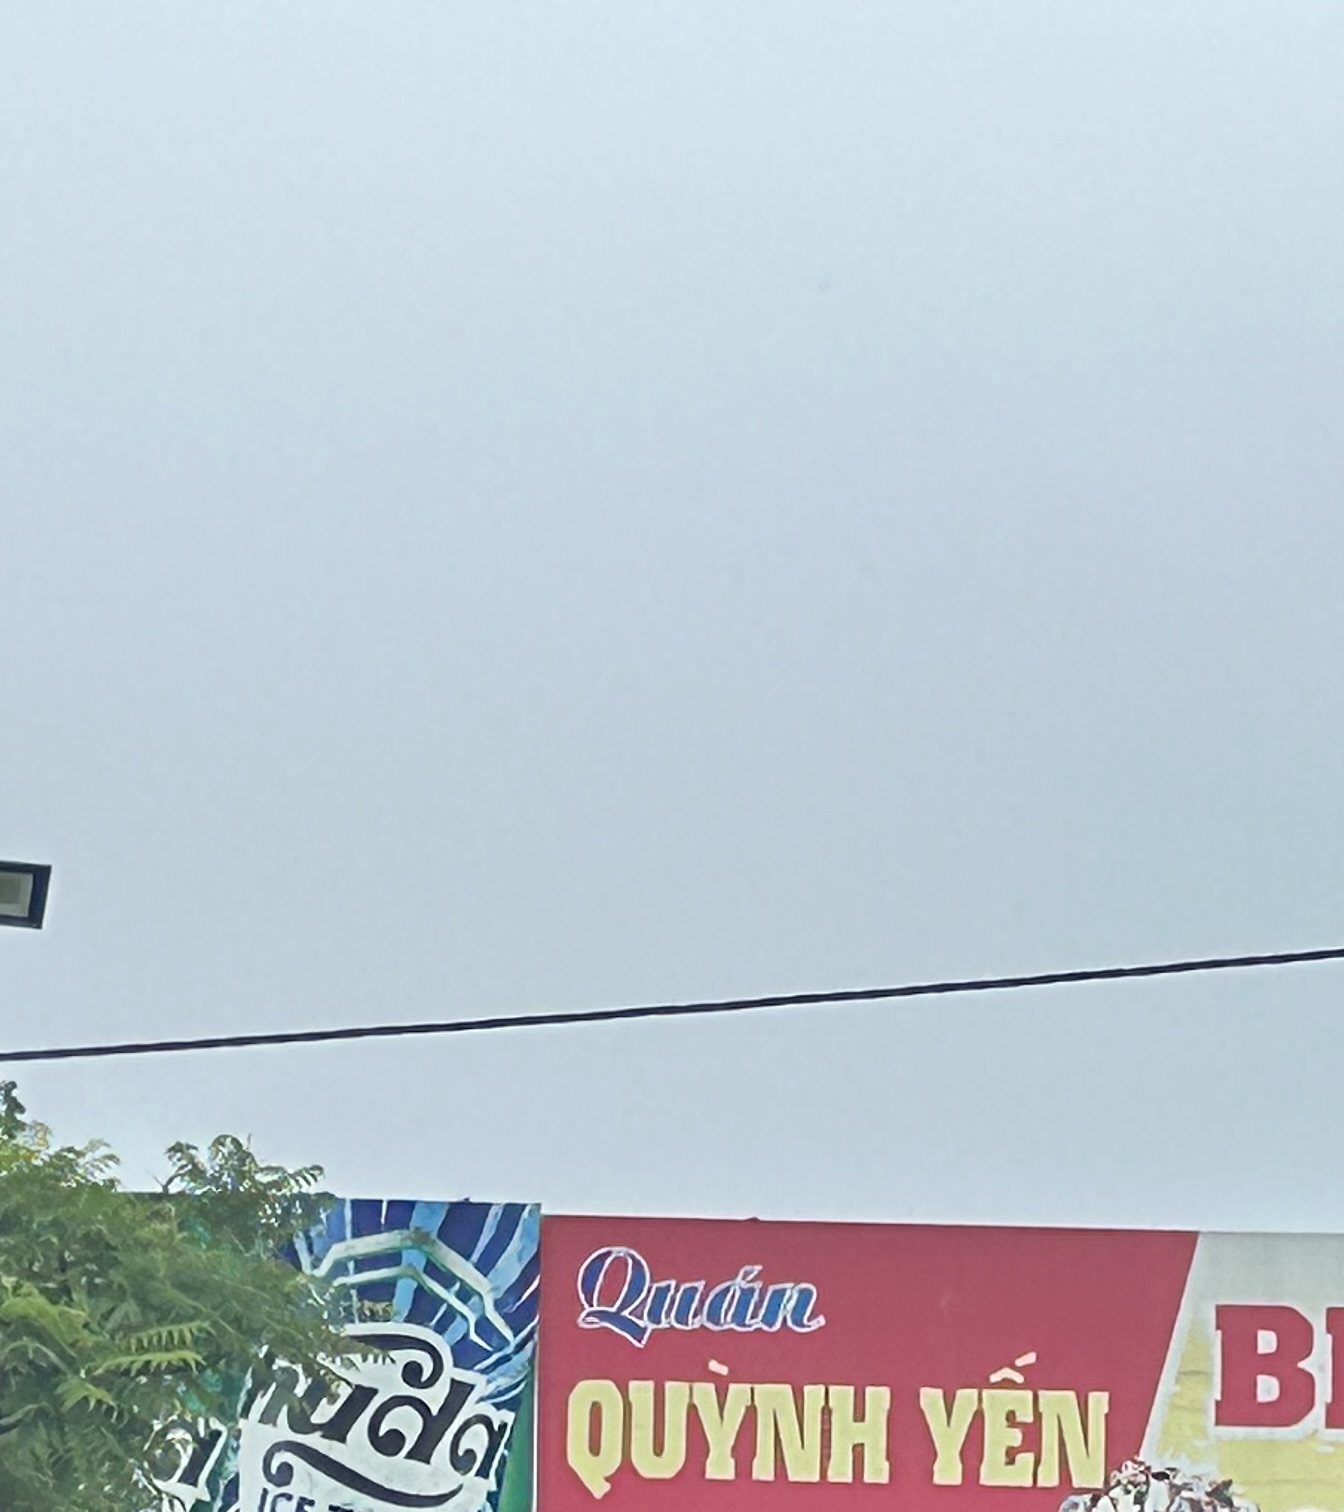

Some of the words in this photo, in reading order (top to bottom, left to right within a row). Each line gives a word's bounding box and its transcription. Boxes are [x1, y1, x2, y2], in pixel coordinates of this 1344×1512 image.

[577, 1246, 825, 1347] Quán
[566, 1360, 890, 1499] QUỲNH
[920, 1352, 1110, 1489] YẾN
